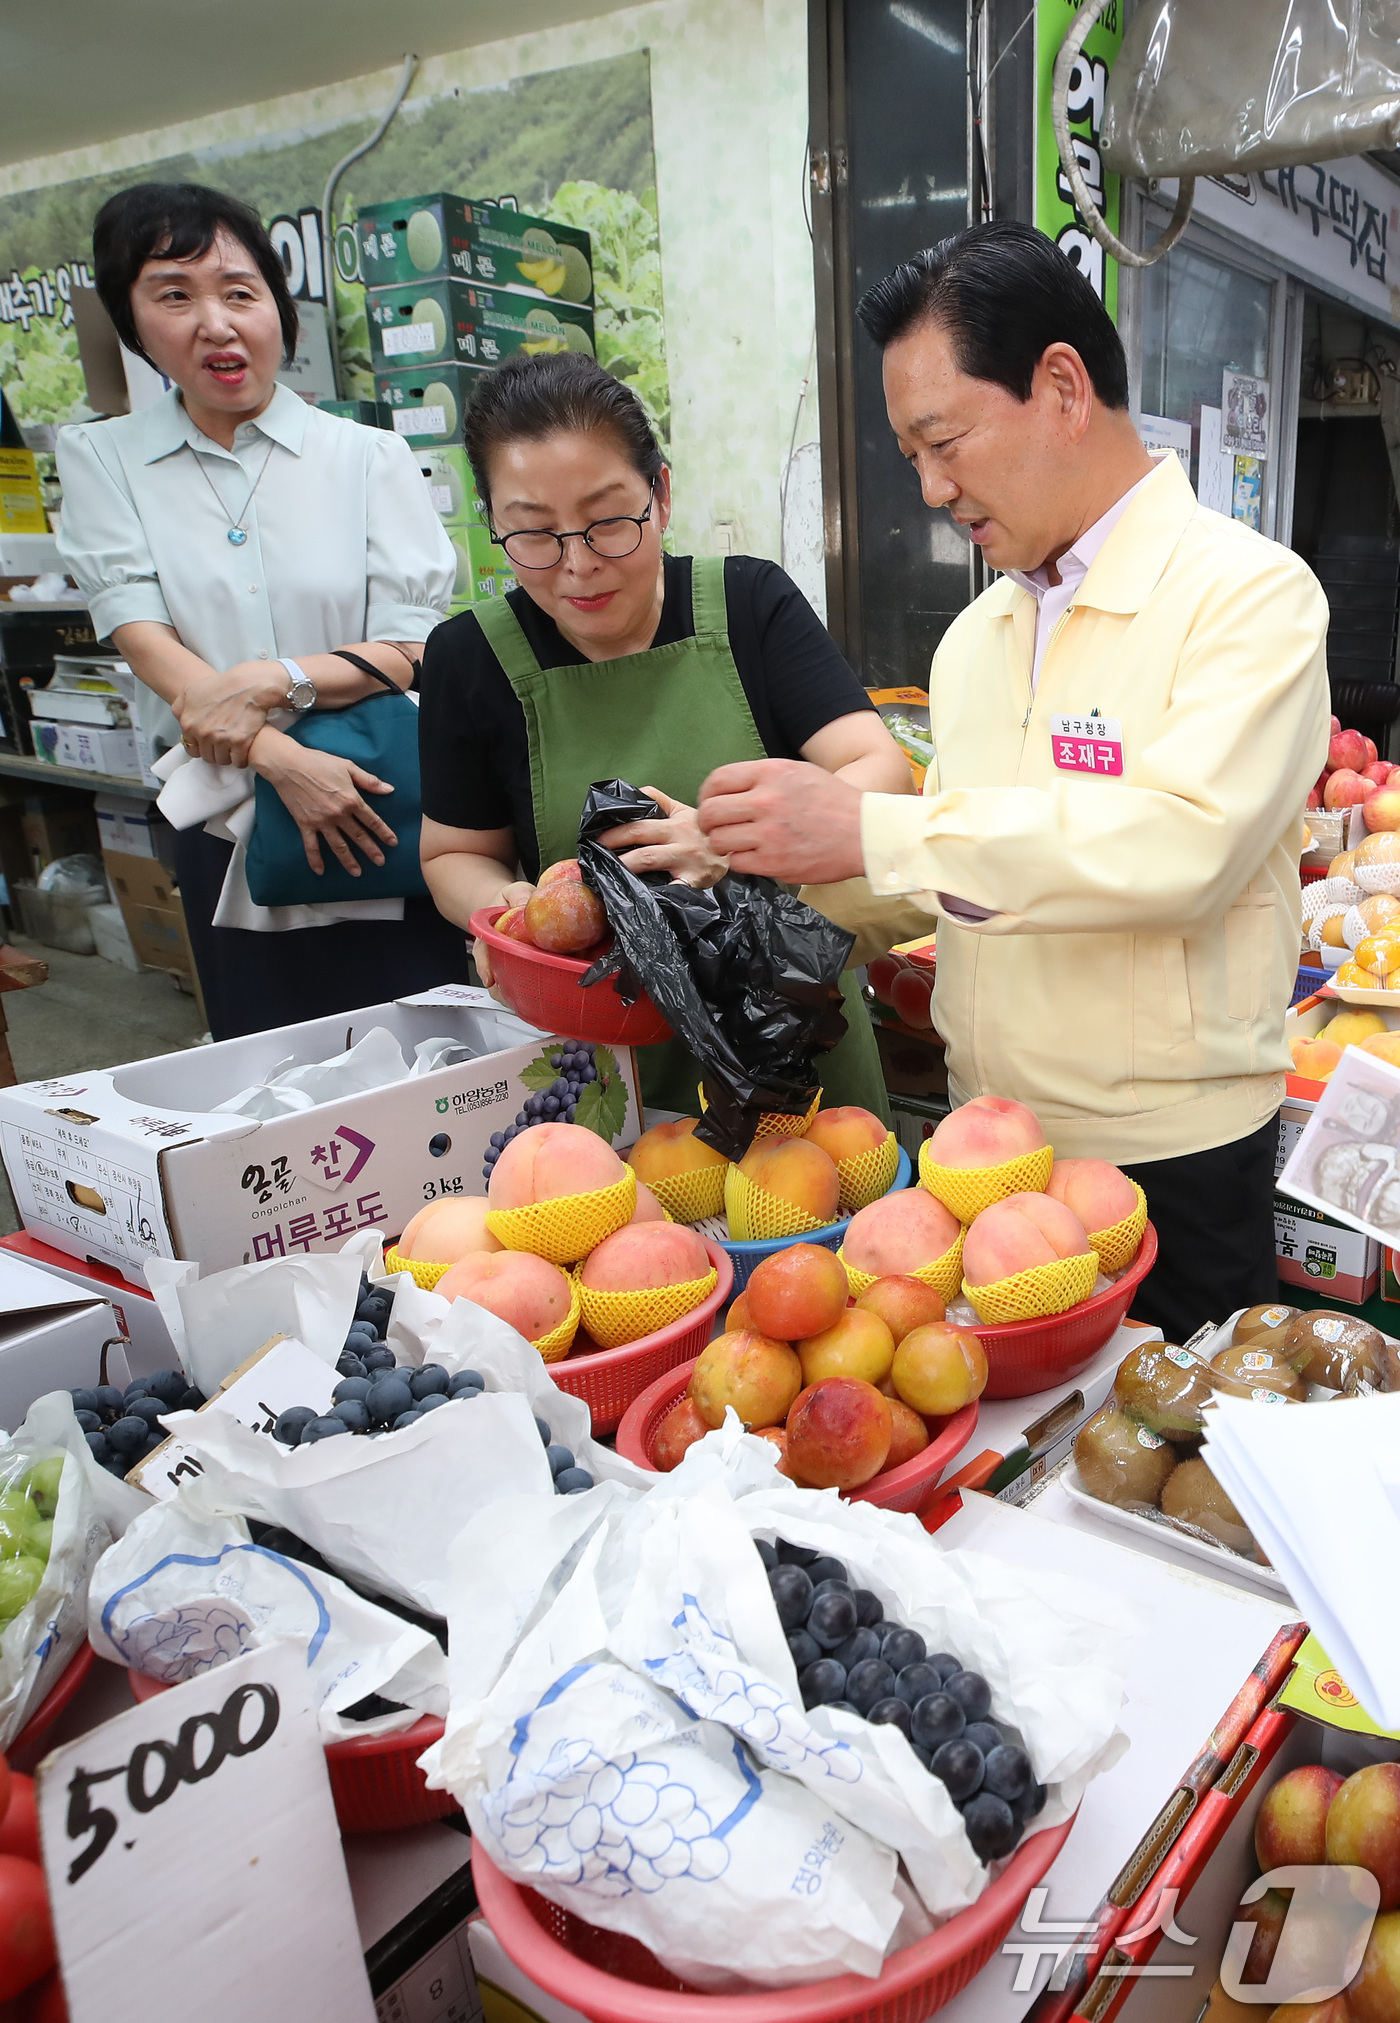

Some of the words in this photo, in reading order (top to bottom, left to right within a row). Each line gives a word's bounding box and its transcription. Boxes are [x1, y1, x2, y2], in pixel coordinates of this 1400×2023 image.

[363, 231, 398, 261] 메론
[527, 240, 563, 256] MELON
[451, 249, 498, 280] 메론
[530, 320, 566, 336] MELON
[456, 333, 501, 362] 메론
[1061, 720, 1106, 737] 남구청장
[1058, 742, 1116, 771] 조재구
[452, 1079, 509, 1107] 하양농협
[251, 1195, 307, 1220] Ongolchan
[251, 1190, 389, 1263] 머루포도
